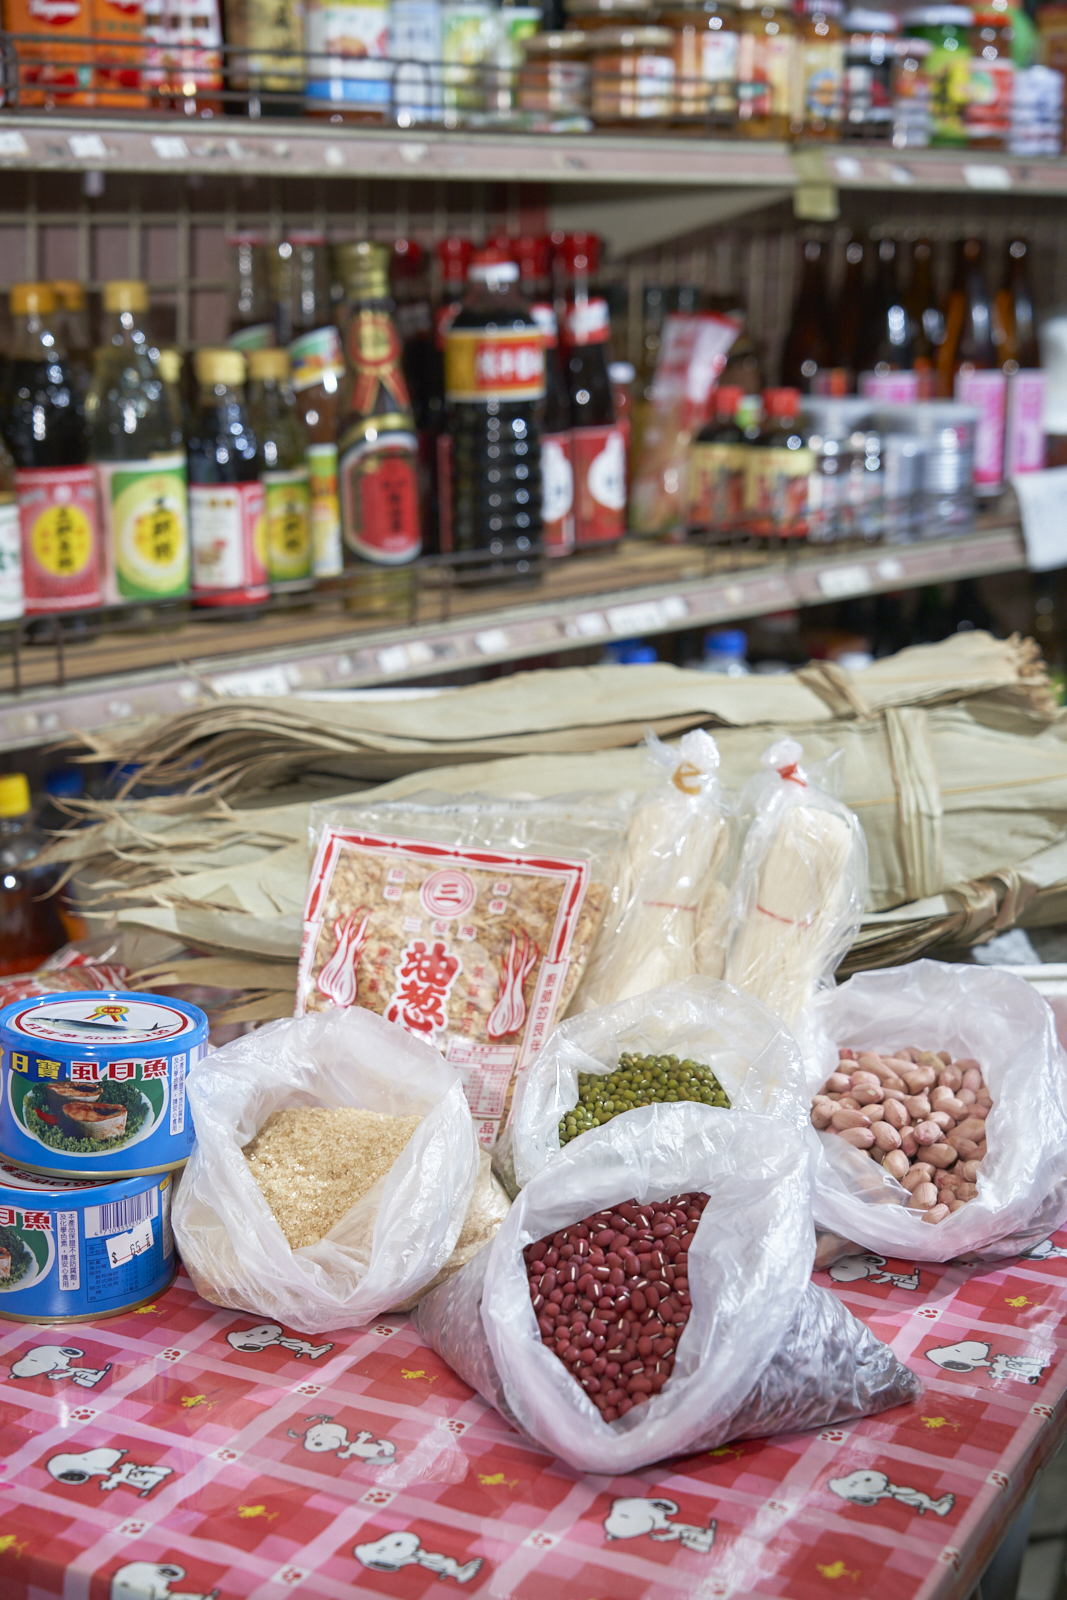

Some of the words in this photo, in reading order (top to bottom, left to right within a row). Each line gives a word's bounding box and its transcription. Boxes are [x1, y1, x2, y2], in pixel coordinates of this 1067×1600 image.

[434, 884, 462, 904] 三
[388, 942, 459, 1036] 油葱
[12, 1052, 61, 1080] 日寶
[72, 1058, 168, 1081] 虱目魚
[129, 1240, 142, 1256] 65
